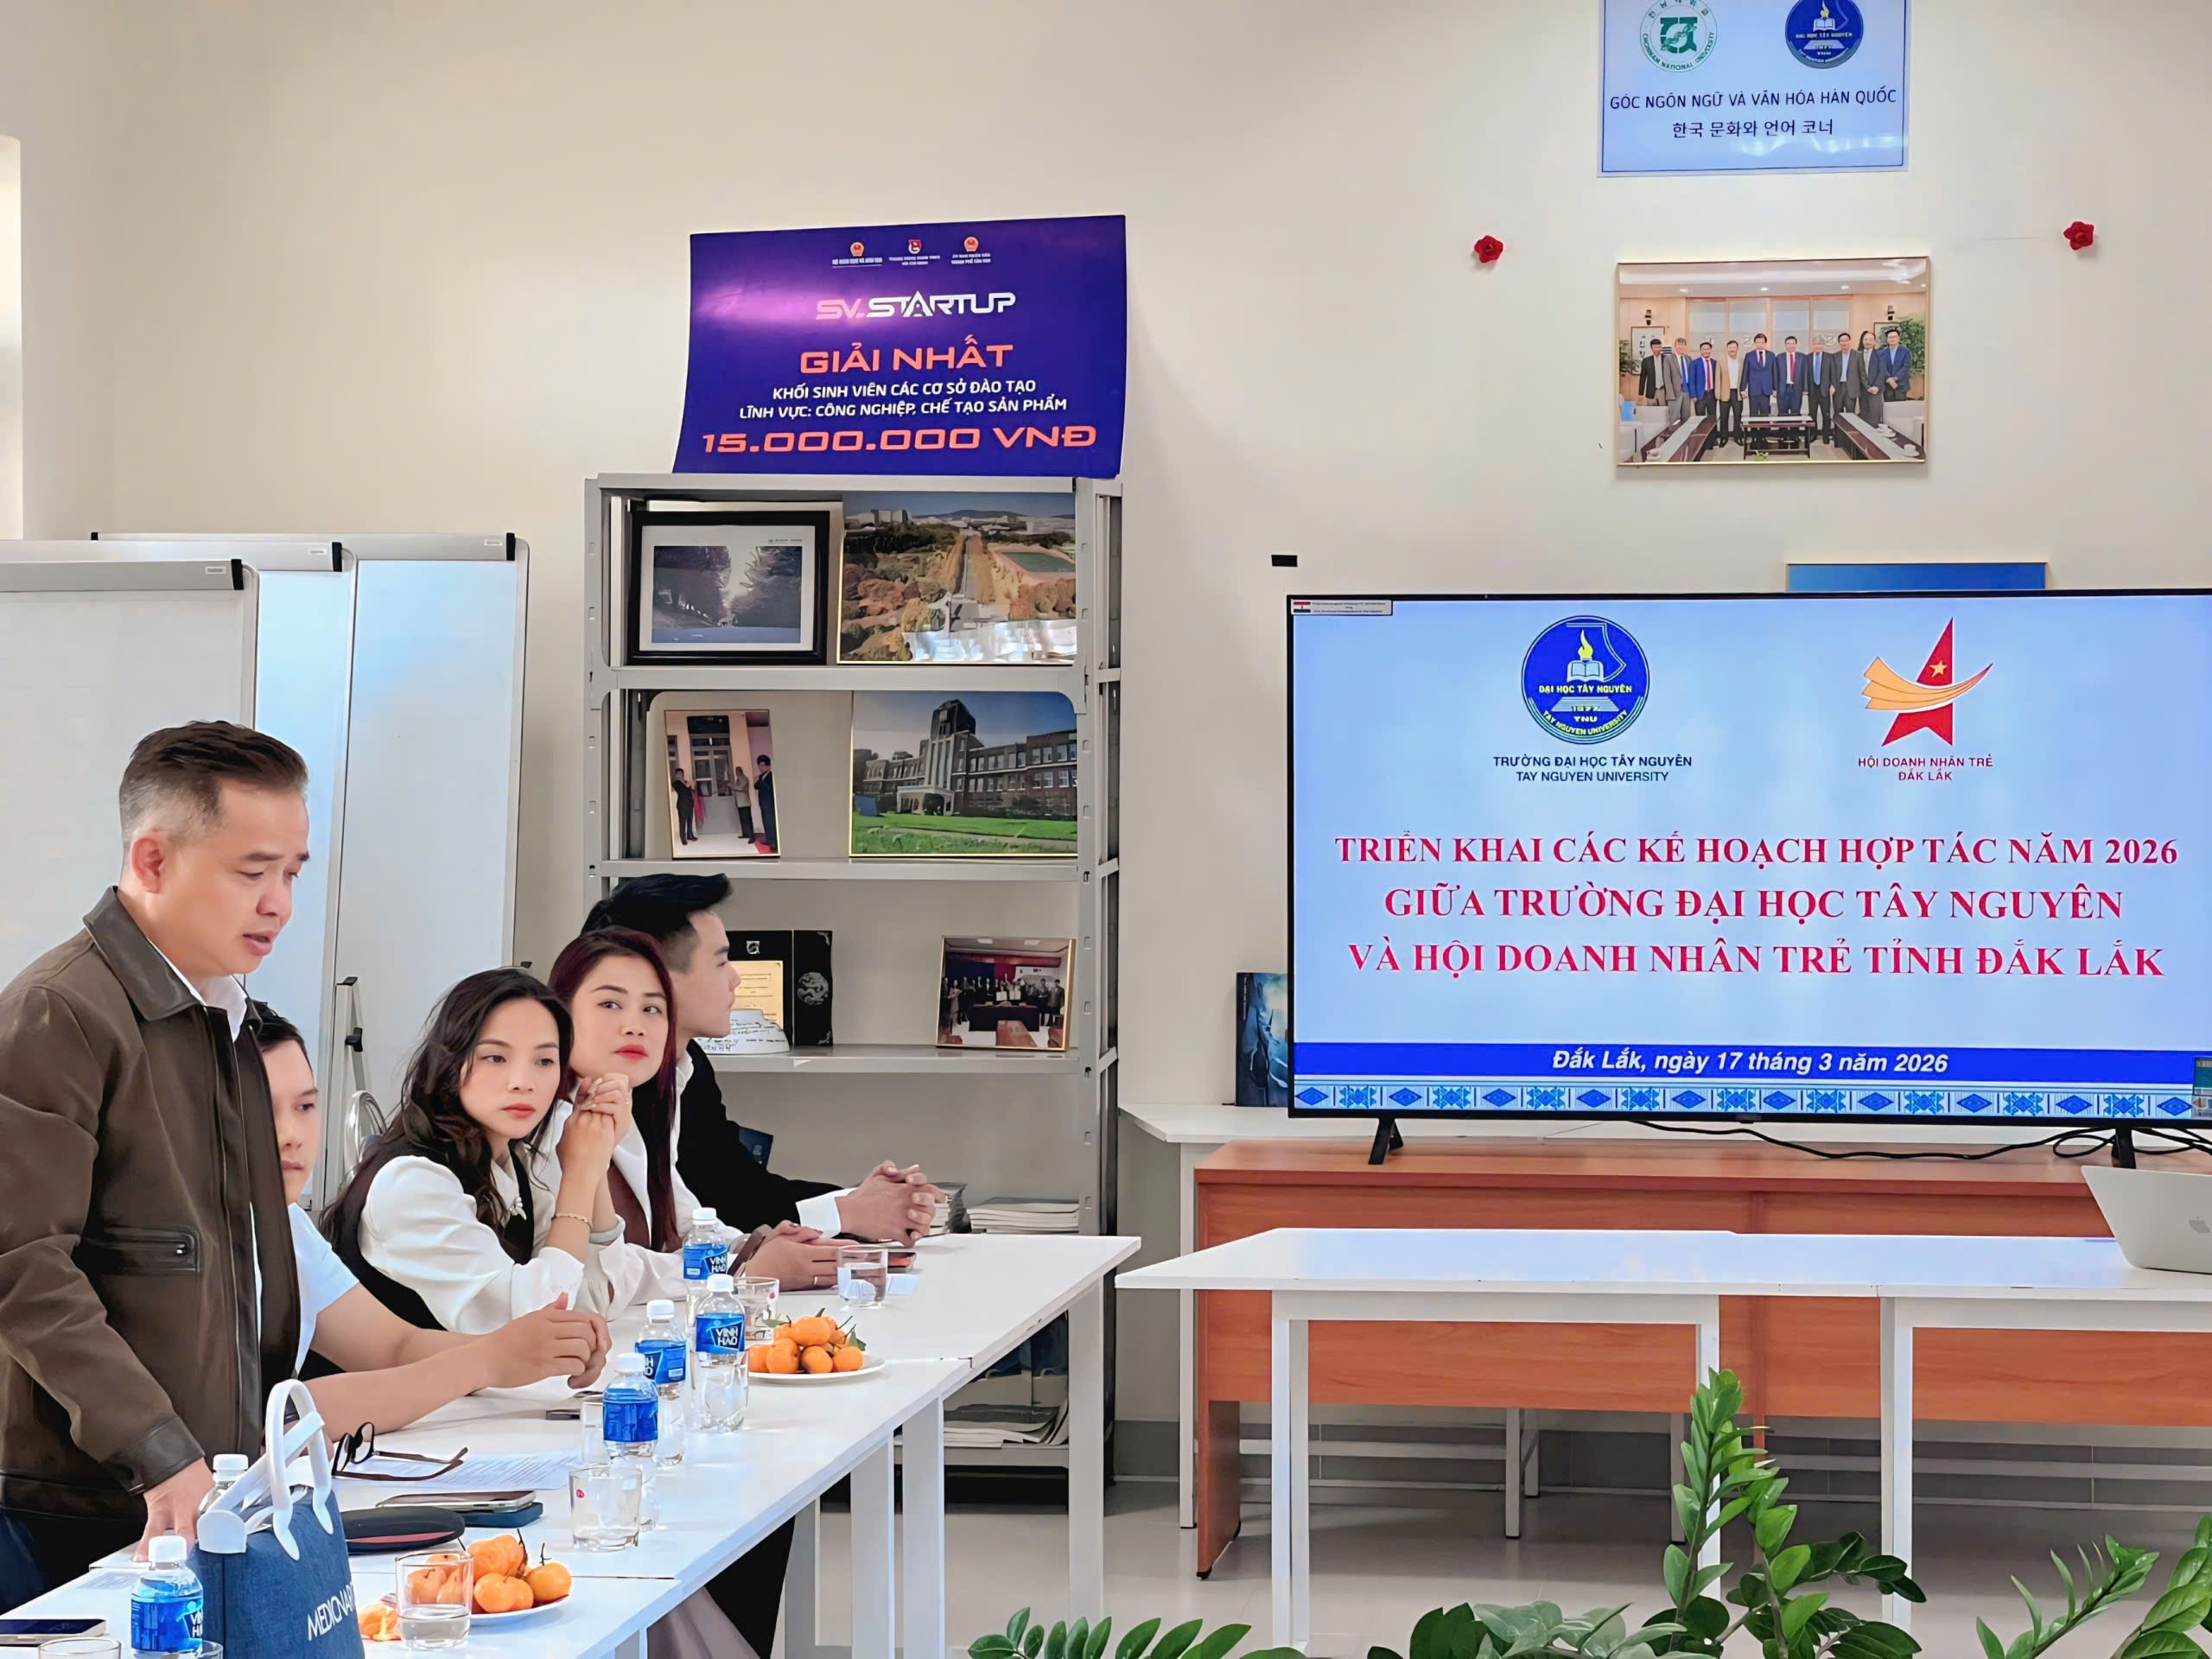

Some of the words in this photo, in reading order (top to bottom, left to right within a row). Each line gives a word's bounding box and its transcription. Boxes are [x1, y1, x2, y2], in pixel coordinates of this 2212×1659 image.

[1645, 92, 1686, 108] NGÔN
[1692, 91, 1724, 107] NGỮ
[1729, 90, 1746, 106] VÀ
[1751, 89, 1779, 105] VĂN
[1785, 89, 1815, 105] HÓA
[1821, 88, 1850, 104] HÀN
[1855, 85, 1897, 105] QUỐC
[1673, 122, 1704, 138] 한국
[1709, 120, 1758, 137] 문화와
[1764, 119, 1796, 137] 언어
[1802, 118, 1833, 135] 코너
[800, 342, 880, 373] GIẢI
[893, 334, 1014, 371] NHẤT
[772, 383, 809, 399] KHỐI
[812, 386, 849, 399] SINH
[852, 382, 887, 397] VIÊN
[891, 381, 918, 396] CÁC
[923, 382, 944, 395] CƠ
[946, 378, 967, 394] SỞ
[969, 378, 1001, 394] ĐÀO
[1006, 380, 1036, 395] TẠO
[739, 405, 773, 419] LĨNH
[778, 406, 811, 420] VỰC:
[816, 403, 856, 416] CÔNG
[860, 400, 916, 417] NGHIỆP,
[921, 397, 952, 414] CHẾ
[954, 401, 984, 416] TẠO
[988, 397, 1019, 412] SẢN
[1023, 393, 1067, 411] PHẨM
[702, 428, 980, 453] 15.000.000
[993, 425, 1096, 448] VNĐ
[1493, 753, 1551, 767] TRƯỜNG
[1554, 756, 1576, 768] ĐẠI
[1580, 756, 1607, 769] HỌC
[1611, 754, 1636, 766] TÂY
[1639, 754, 1693, 766] NGUYÊN
[1858, 755, 1878, 768] HỘI
[1883, 757, 1926, 767] DOANH
[1930, 755, 1965, 767] NHÂN
[1968, 753, 1993, 767] TRẺ
[1516, 772, 1538, 782] TAY
[1541, 772, 1593, 782] NGUYEN
[1597, 772, 1669, 782] UNIVERSITY
[1898, 768, 1923, 781] ĐẮK
[1928, 768, 1953, 781] LẮK
[1335, 830, 1440, 863] TRIỂN
[1453, 837, 1543, 863] KHAI
[1553, 830, 1627, 863] CÁC
[1637, 830, 1686, 863] KẾ
[1695, 837, 1827, 870] HOẠCH
[1839, 836, 1915, 870] HỢP
[1922, 831, 1998, 865] TÁC
[2007, 831, 2094, 865] NĂM
[2105, 838, 2177, 865] 2026
[1384, 882, 1484, 917] GIỮA
[1494, 881, 1665, 918] TRƯỜNG
[1675, 889, 1745, 925] ĐẠI
[1757, 889, 1845, 925] HỌC
[1856, 881, 1938, 918] TÂY
[1949, 883, 2124, 919] NGUYÊN
[1348, 936, 1400, 971] VÀ
[1413, 940, 1484, 978] HỘI
[1497, 944, 1638, 973] DOANH
[1649, 938, 1762, 973] NHÂN
[1773, 938, 1852, 974] TRẺ
[1864, 938, 1964, 975] TỈNH
[1976, 938, 2065, 976] ĐẮK
[2076, 938, 2164, 976] LẮK
[1552, 1046, 1595, 1070] Đắk
[1601, 1047, 1647, 1073] Lắk,
[1654, 1052, 1709, 1075] ngày
[1718, 1052, 1741, 1071] 17
[1748, 1050, 1812, 1075] tháng
[1819, 1053, 1833, 1071] 3
[1838, 1052, 1888, 1071] năm
[1894, 1054, 1949, 1073] 2026
